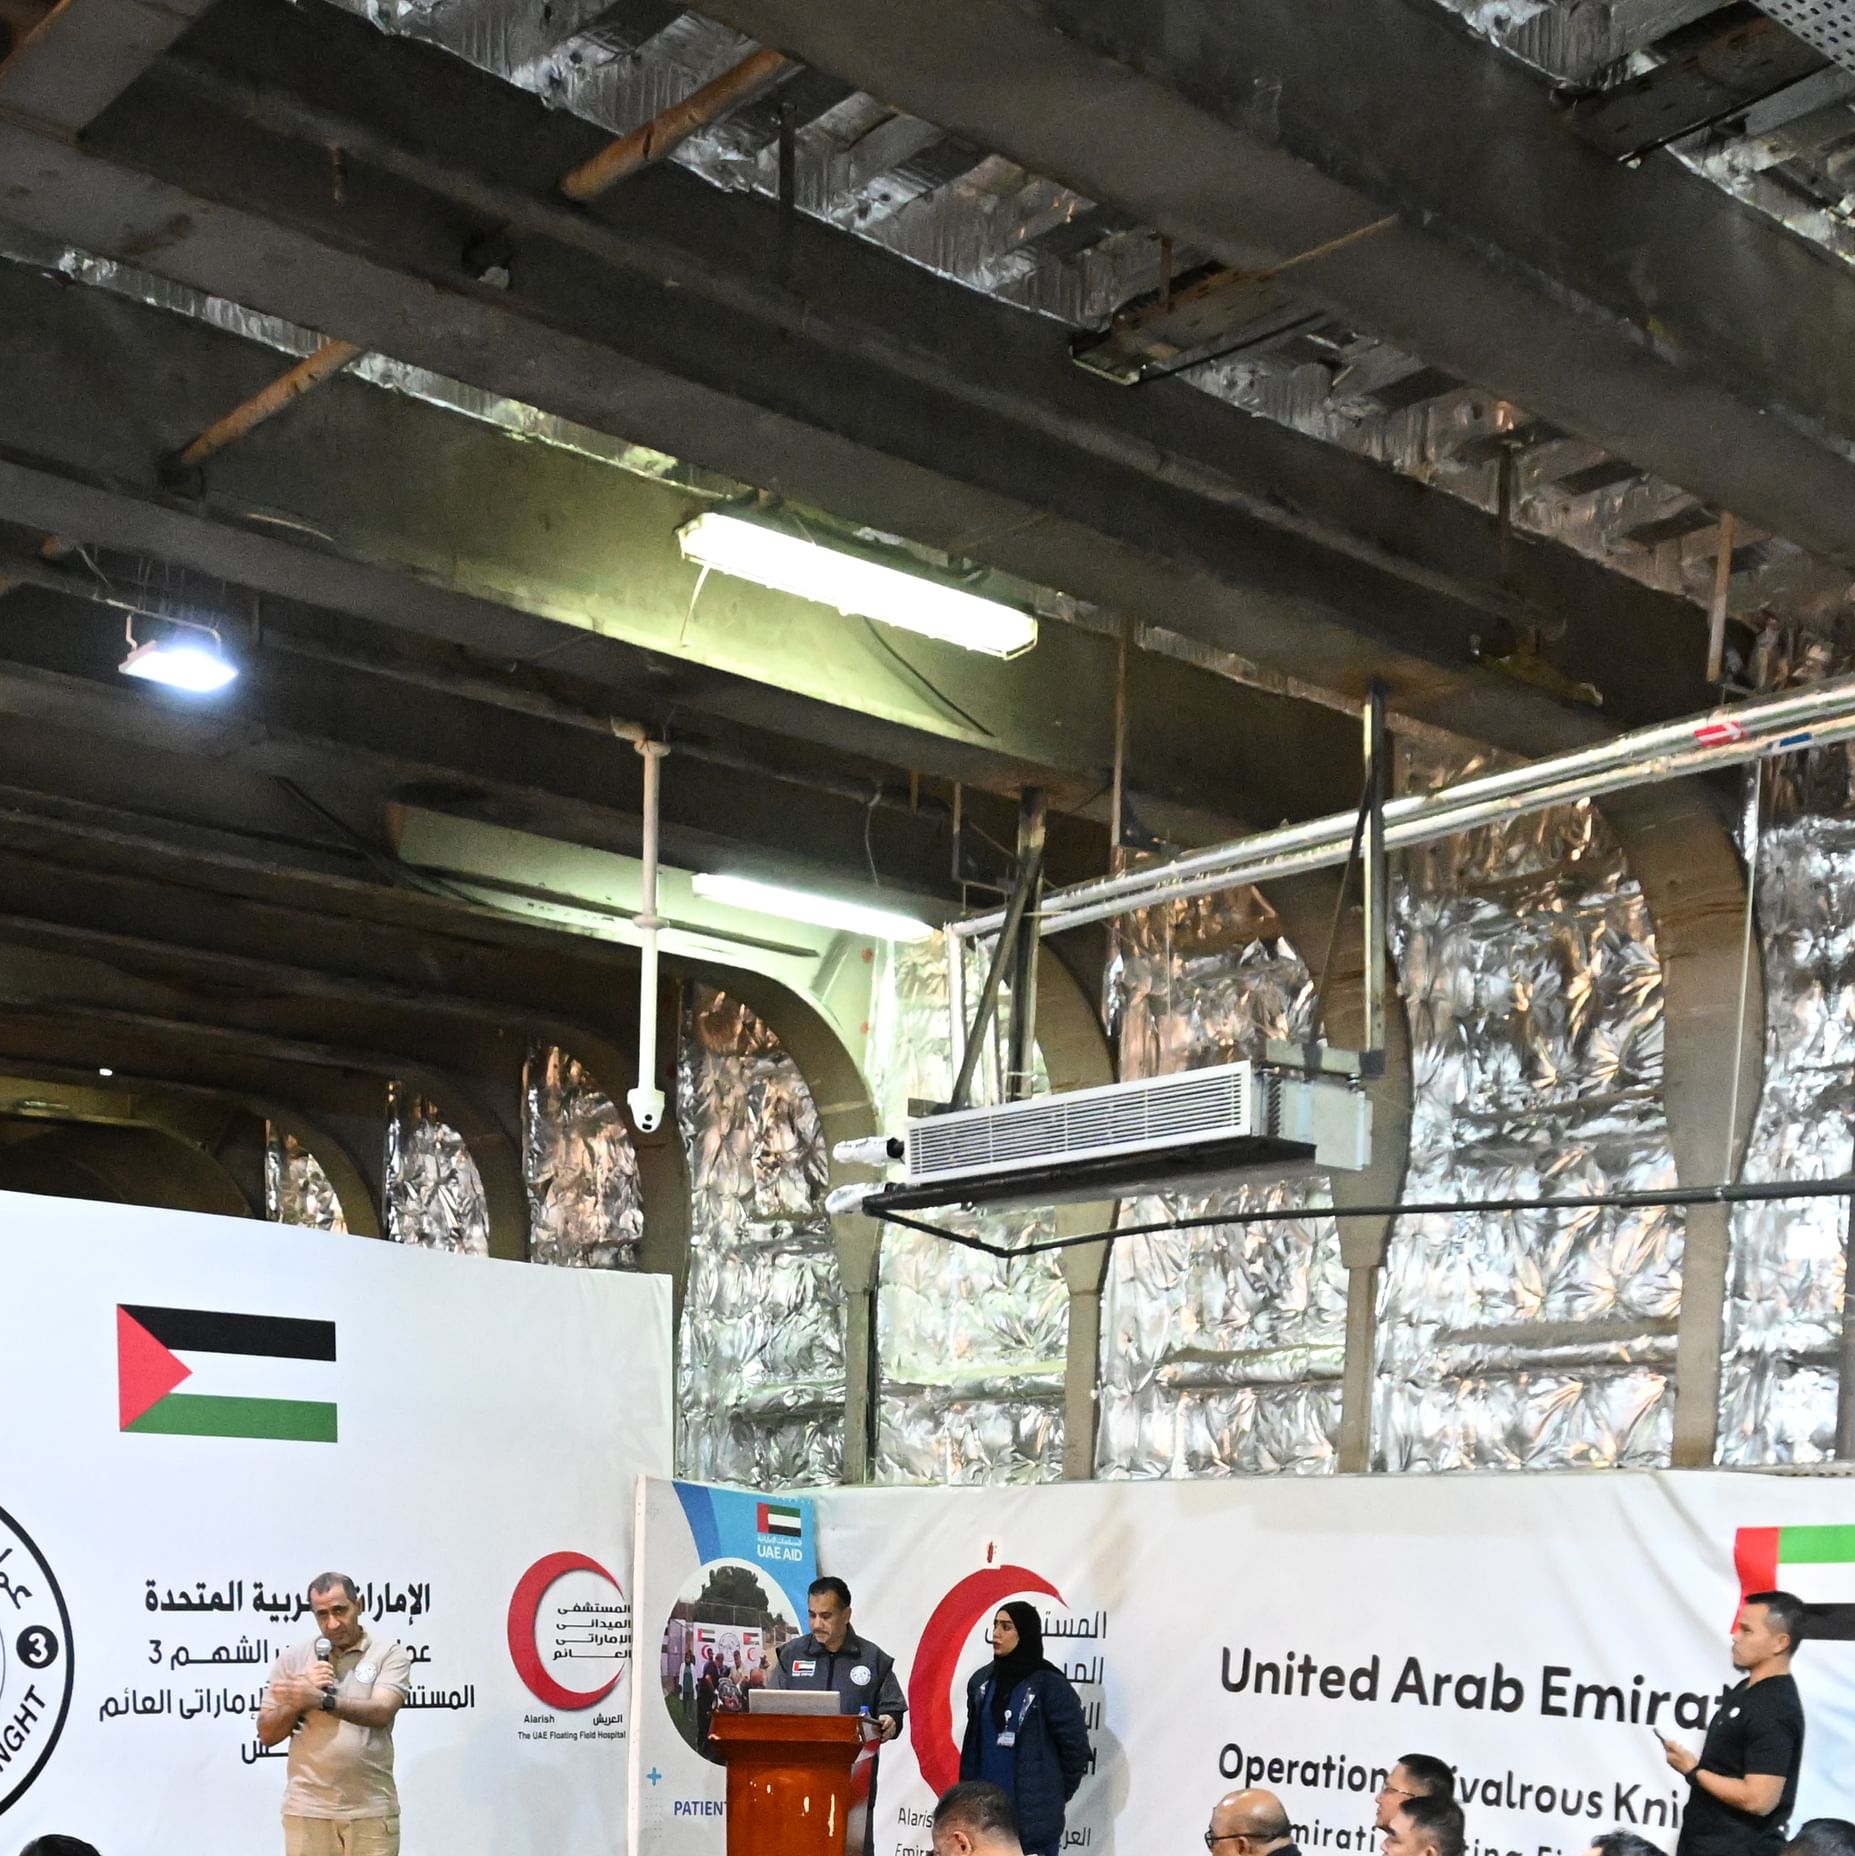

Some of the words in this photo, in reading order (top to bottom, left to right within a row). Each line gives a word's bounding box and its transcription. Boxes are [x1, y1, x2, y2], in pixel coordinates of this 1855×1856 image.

[757, 1544, 781, 1559] UAE
[783, 1547, 803, 1561] AID
[145, 1579, 243, 1612] المتحدة
[252, 1581, 310, 1623] ربية
[557, 1602, 631, 1615] المستشفى
[29, 1632, 47, 1663] 3
[148, 1640, 162, 1664] 3
[171, 1635, 268, 1670] الشهم
[99, 1686, 171, 1721] العائم
[1221, 1646, 1379, 1701] United
[1391, 1656, 1525, 1713] Arab
[1540, 1664, 1732, 1730] Emira
[524, 1714, 555, 1724] Alarish
[517, 1732, 531, 1741] The
[533, 1731, 547, 1740] UAE
[550, 1731, 578, 1742] Floating
[598, 1730, 626, 1741] Hospital
[1218, 1743, 1388, 1794] Operation
[1613, 1782, 1681, 1829] Kni
[897, 1807, 933, 1828] Alaris
[1289, 1819, 1377, 1854] mirati
